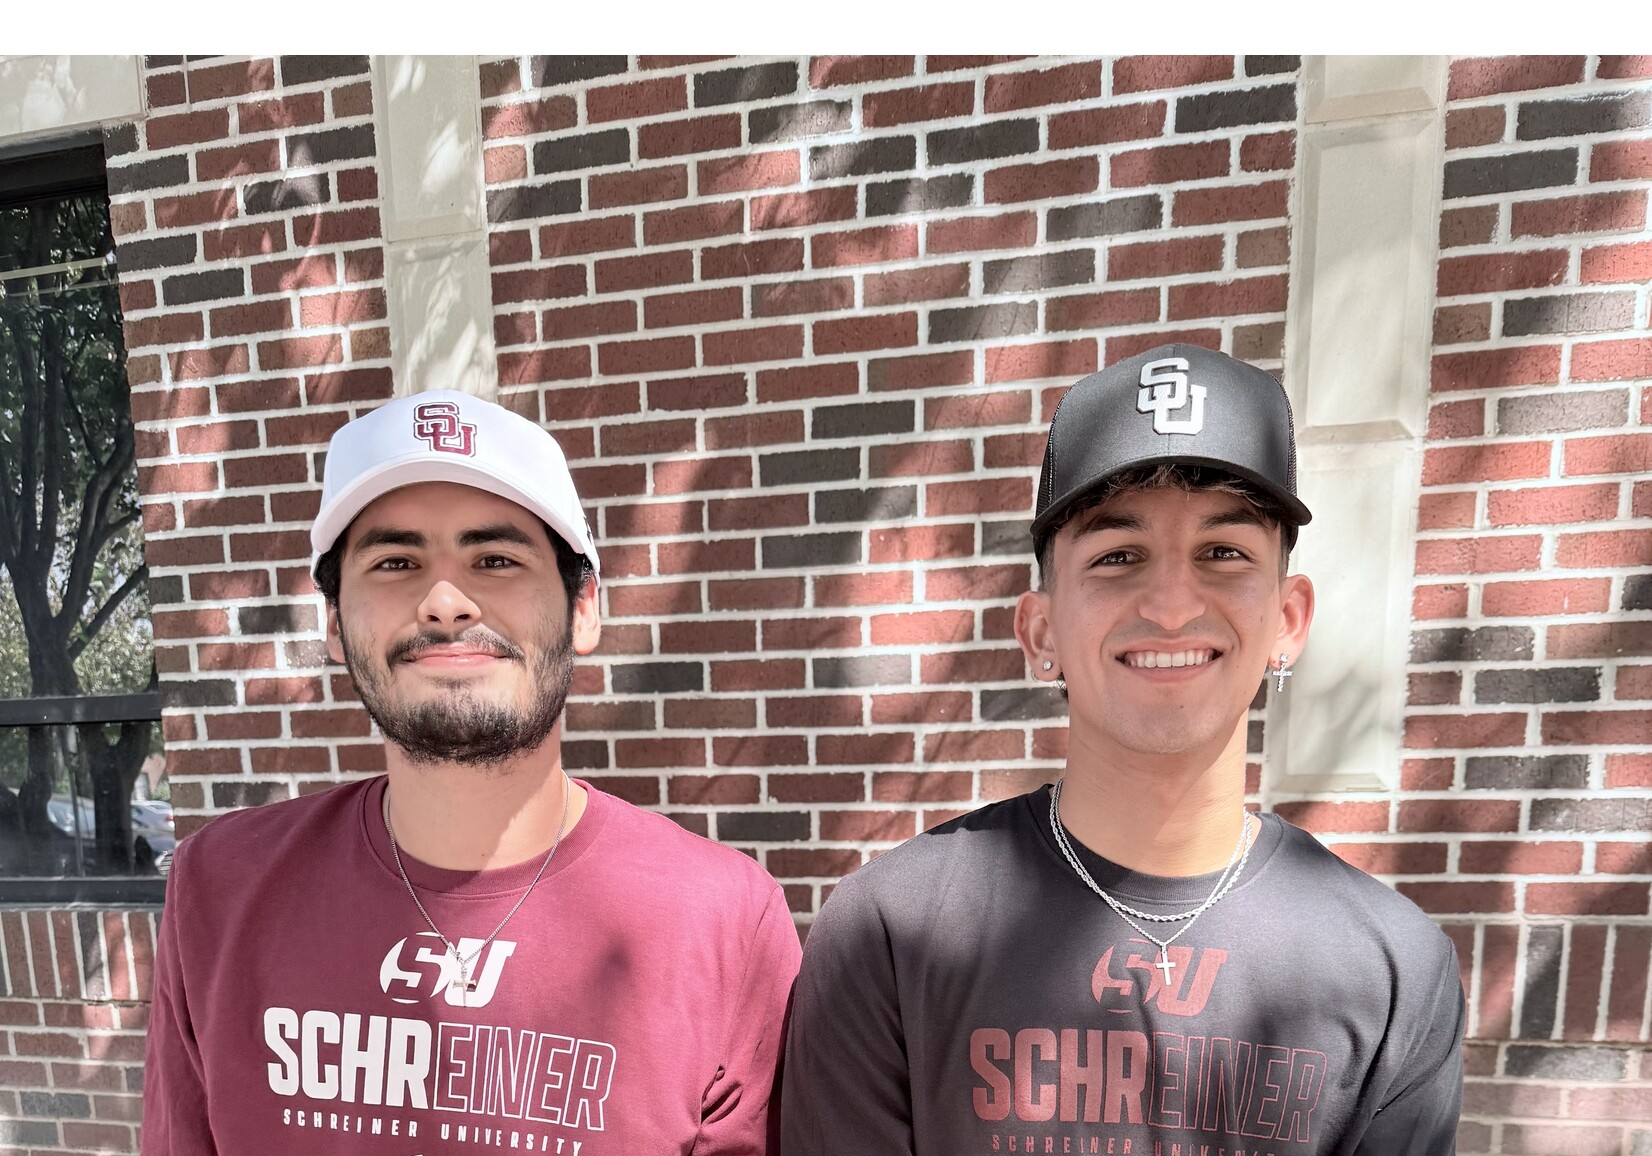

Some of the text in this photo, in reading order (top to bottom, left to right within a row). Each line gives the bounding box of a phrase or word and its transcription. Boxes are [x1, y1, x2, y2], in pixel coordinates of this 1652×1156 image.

[413, 401, 477, 458] SU
[1136, 357, 1207, 435] SU
[379, 931, 517, 1008] SU
[1091, 938, 1229, 1017] SU
[263, 1006, 617, 1131] SCHREINER
[969, 1028, 1328, 1144] SCHREINER
[283, 1108, 418, 1137] SCHREINER
[992, 1134, 1132, 1156] SCHREINER
